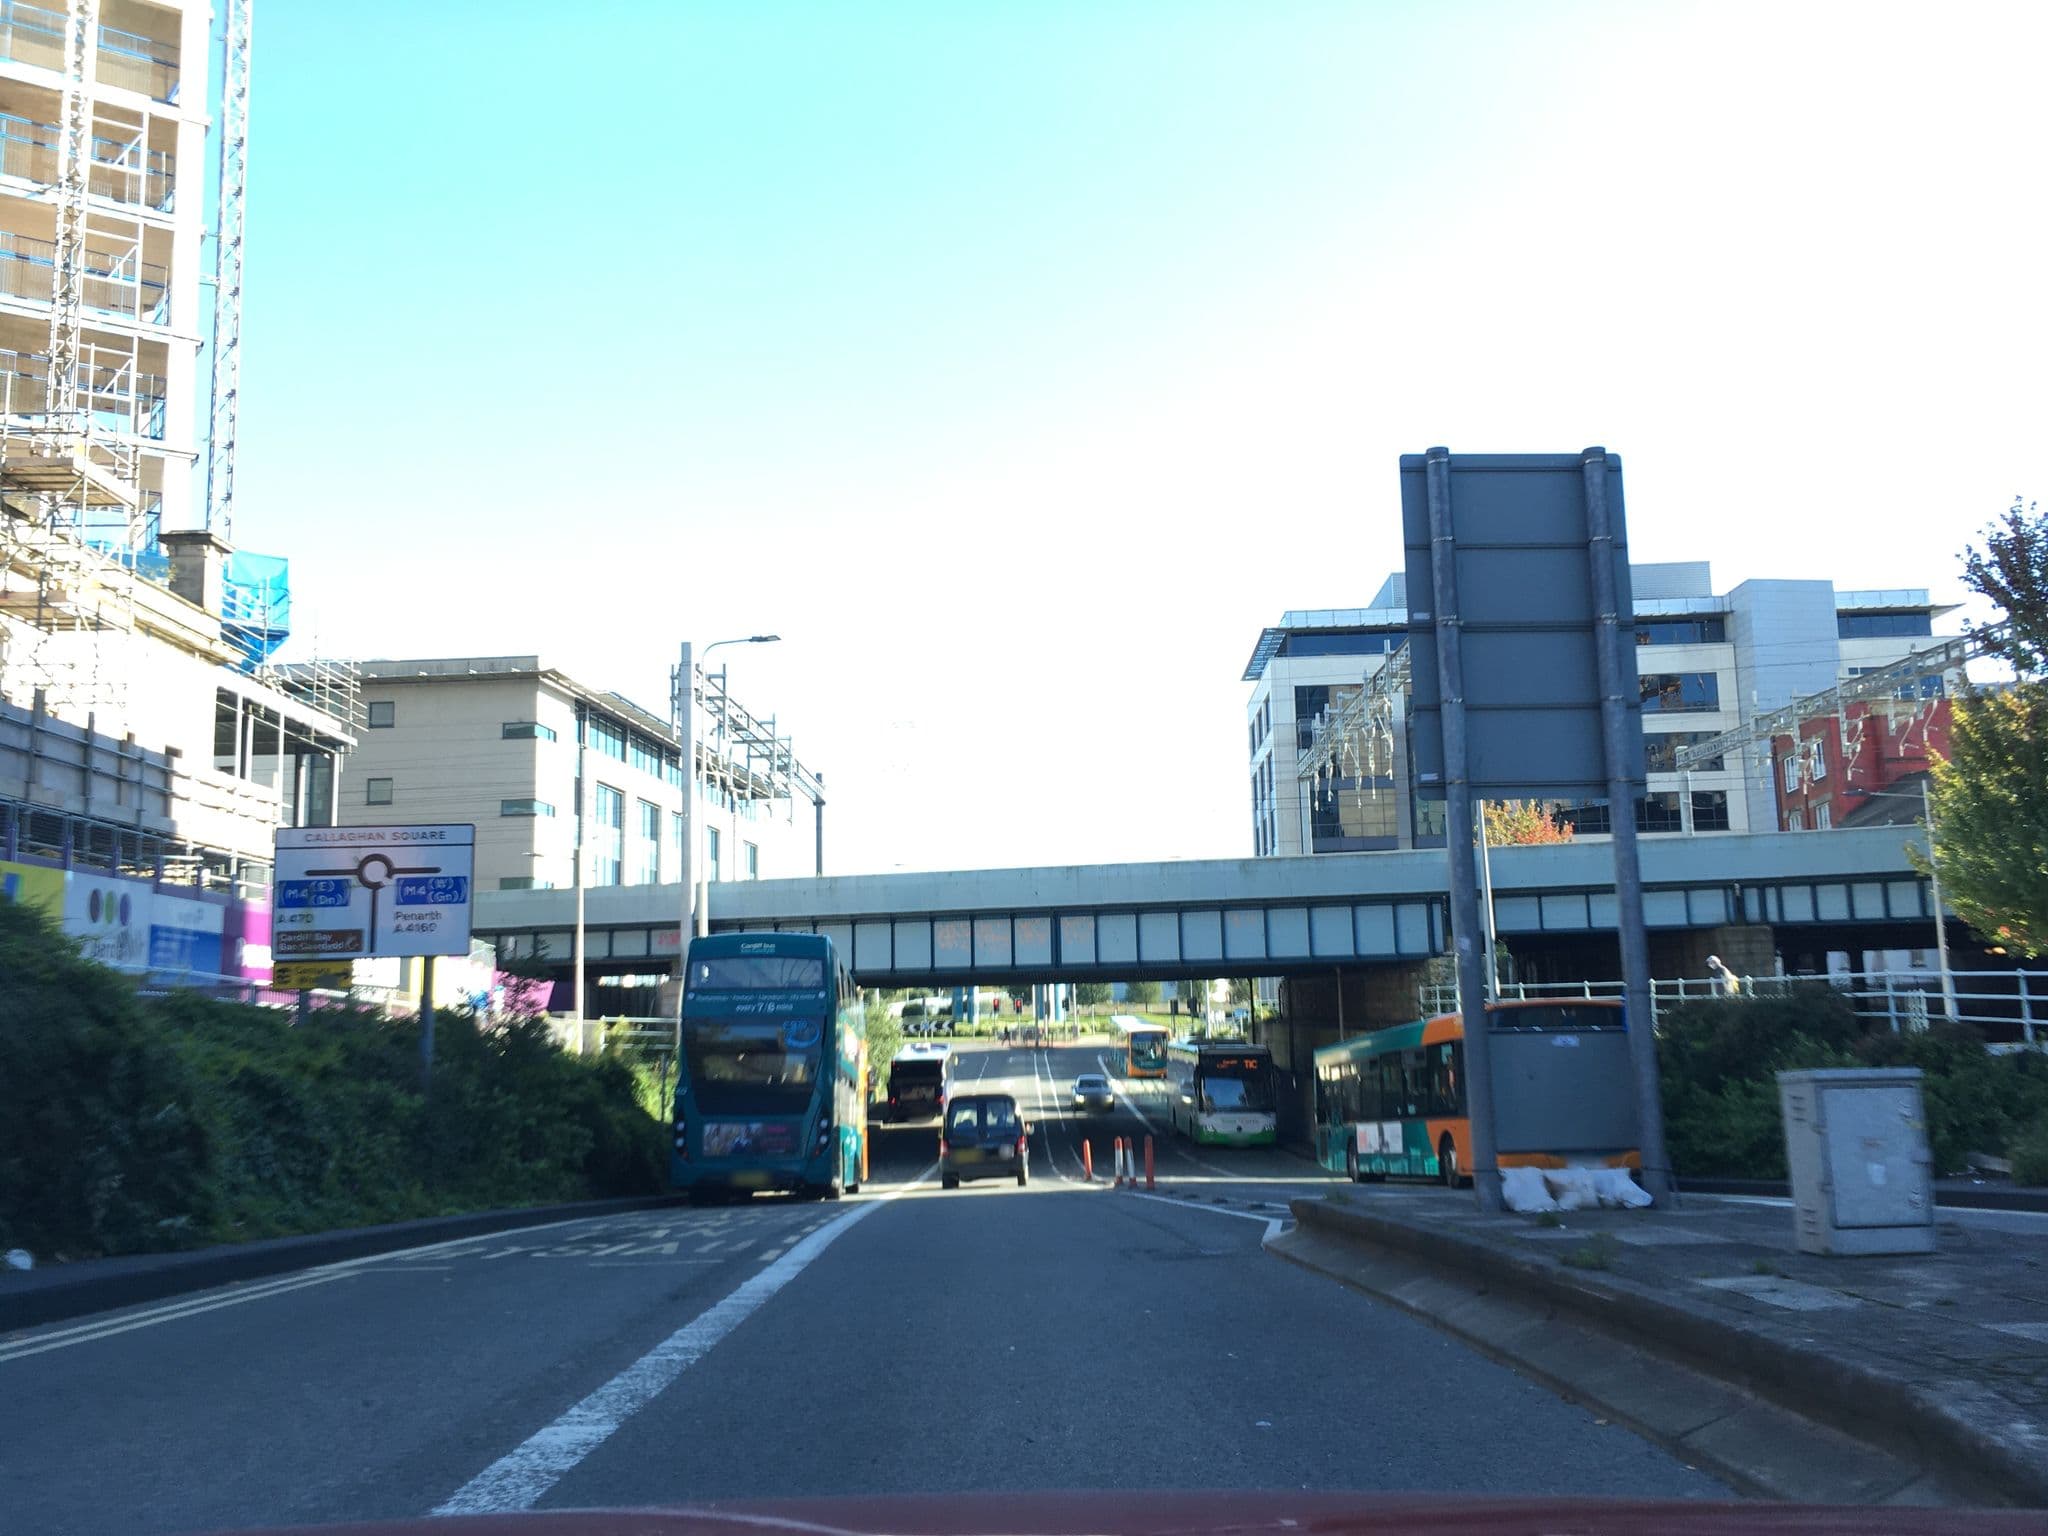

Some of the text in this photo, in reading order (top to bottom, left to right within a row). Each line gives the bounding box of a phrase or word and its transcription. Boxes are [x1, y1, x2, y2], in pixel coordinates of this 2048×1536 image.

[305, 831, 447, 842] CALLAGHAN SQUARE
[396, 911, 442, 920] Penarth
